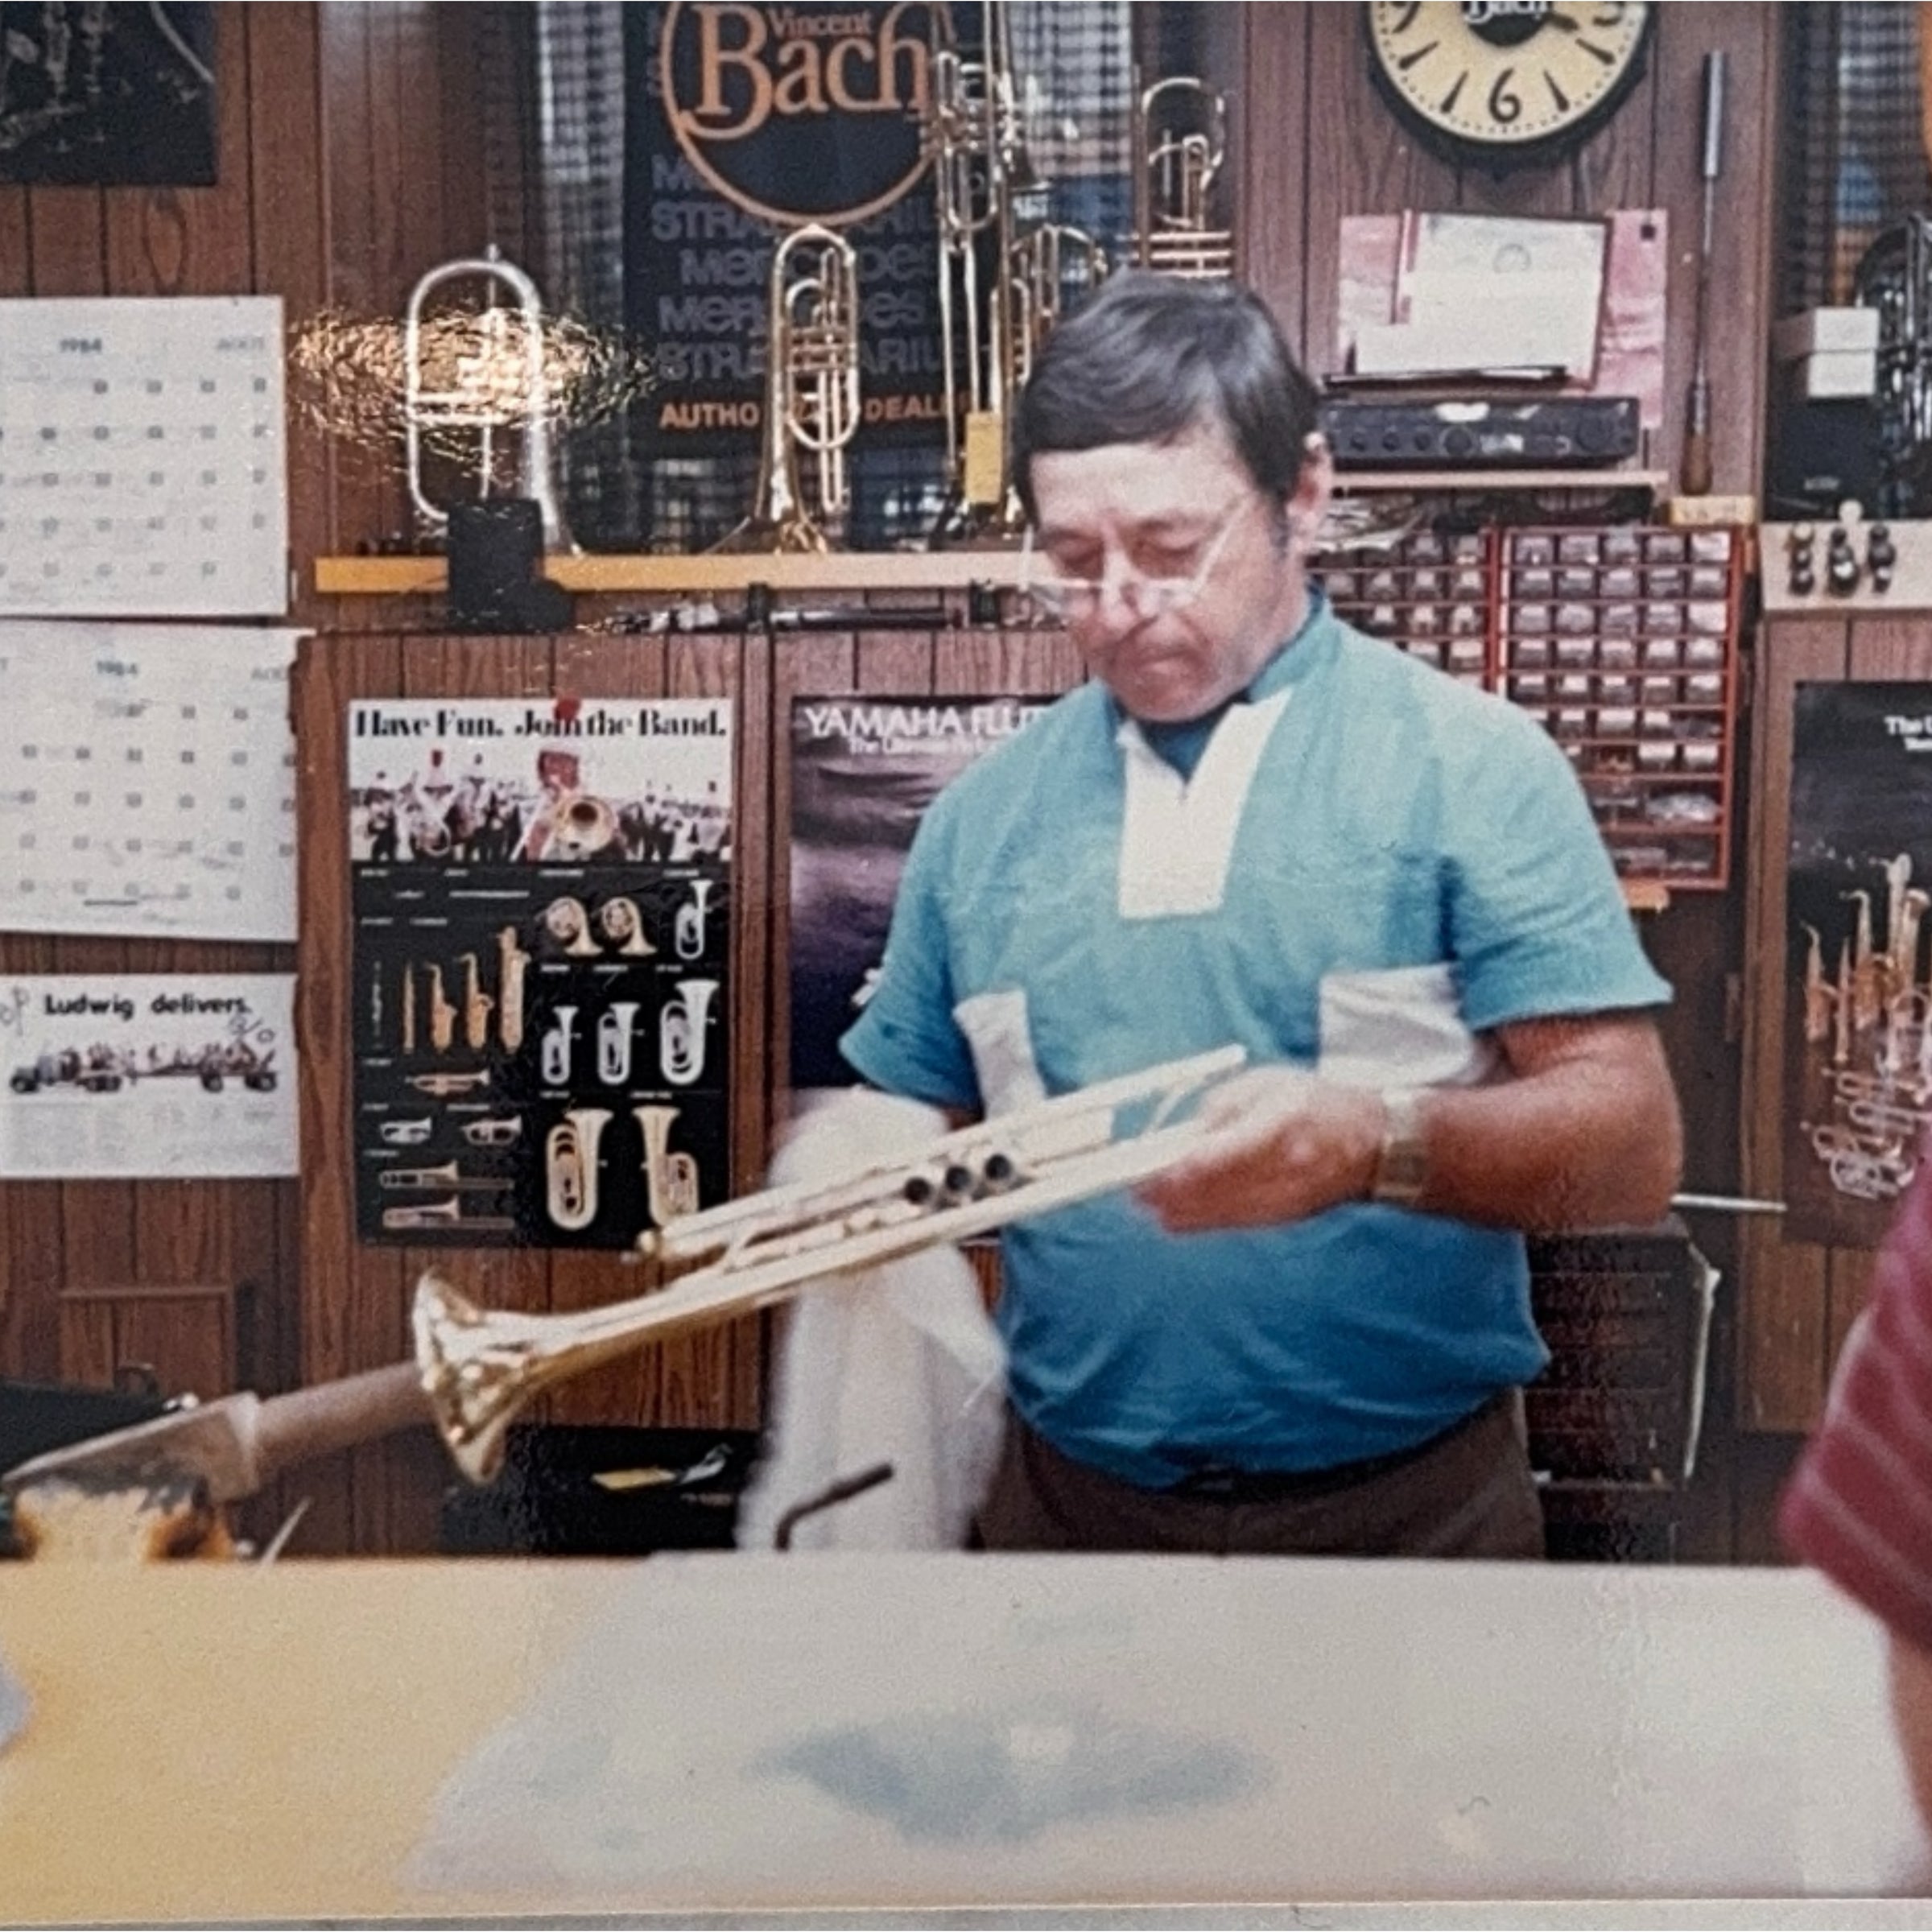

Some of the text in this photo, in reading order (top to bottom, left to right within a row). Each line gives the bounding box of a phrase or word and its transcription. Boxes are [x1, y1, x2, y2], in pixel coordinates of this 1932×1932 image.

[766, 6, 872, 38] Vincent
[683, 1, 928, 139] Bach
[1489, 68, 1521, 123] 6
[357, 710, 727, 736] Have Fun. Join the Band.
[806, 706, 964, 737] YAMAHA
[45, 993, 134, 1022] Ludwig
